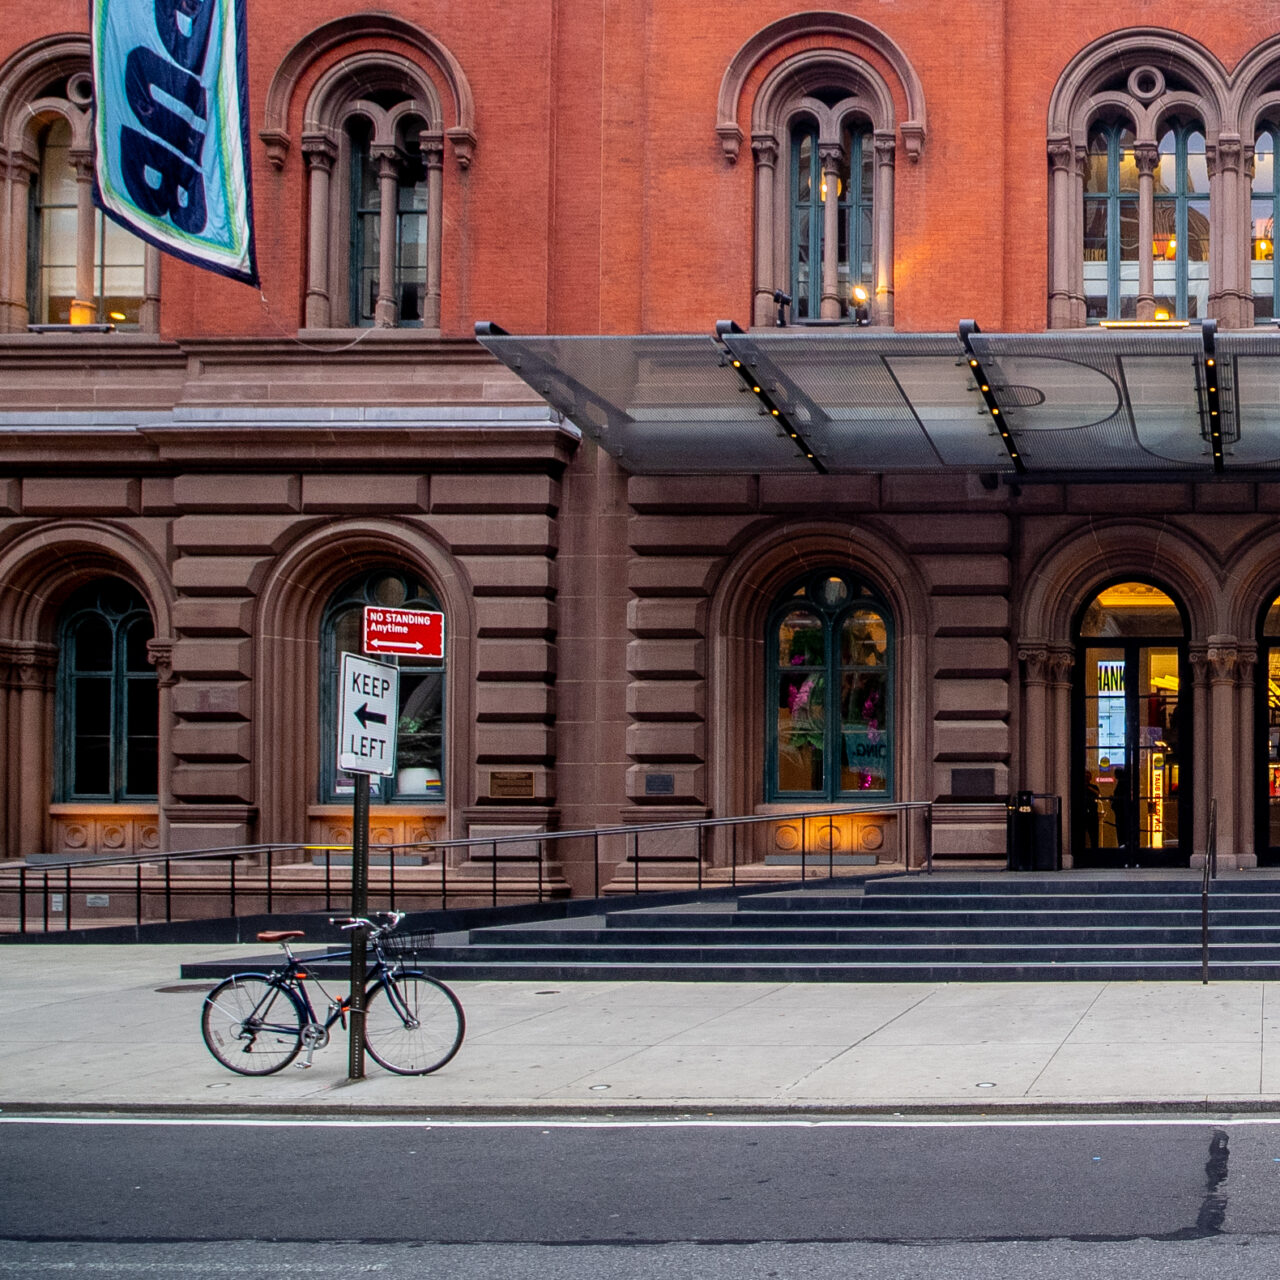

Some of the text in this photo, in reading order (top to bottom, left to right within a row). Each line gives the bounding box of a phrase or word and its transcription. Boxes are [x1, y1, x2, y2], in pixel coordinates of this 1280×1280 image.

[370, 612, 431, 625] NO STANDING
[370, 624, 408, 634] Anytime
[352, 671, 390, 699] KEEP
[351, 734, 386, 760] LEFT
